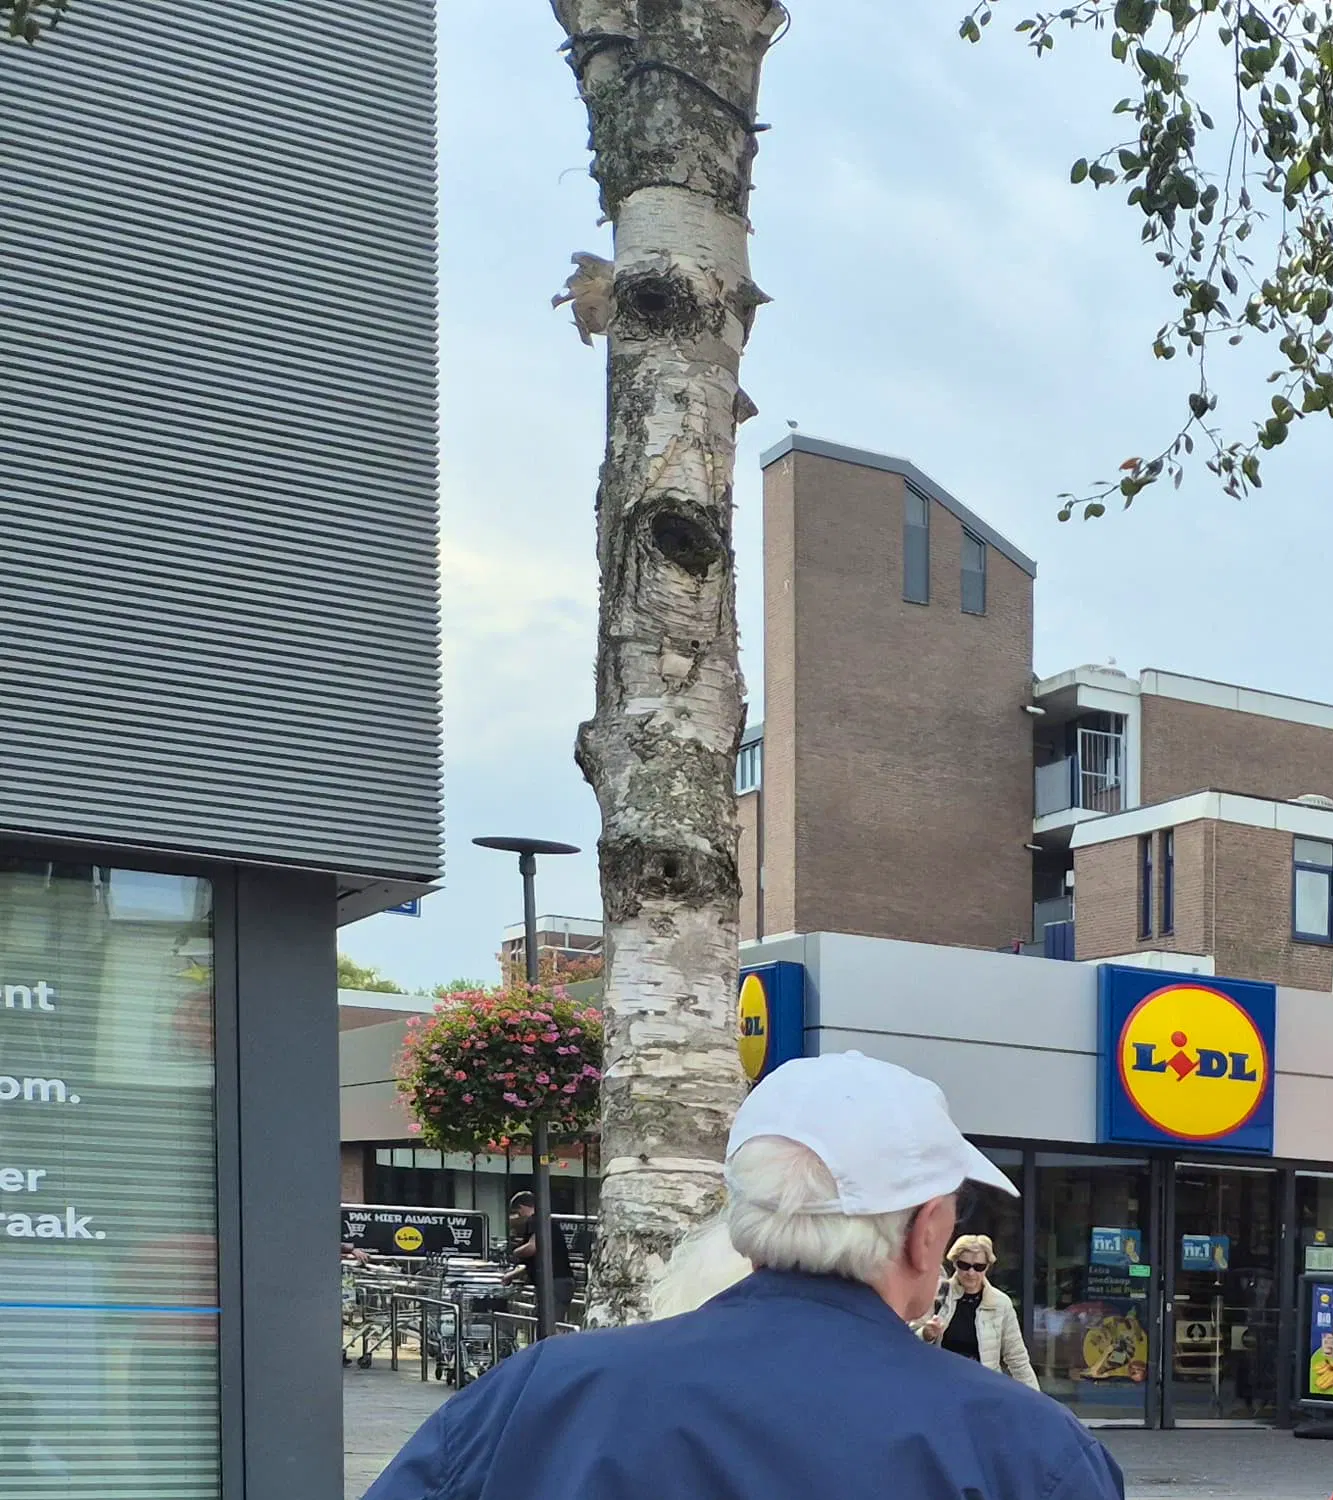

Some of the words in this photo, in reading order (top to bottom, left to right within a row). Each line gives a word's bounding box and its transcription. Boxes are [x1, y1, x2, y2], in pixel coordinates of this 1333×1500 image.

[349, 1211, 372, 1222] PAK
[374, 1213, 402, 1223] HIER
[404, 1214, 445, 1225] ALVAST
[447, 1216, 467, 1227] UW
[1093, 1236, 1121, 1251] nr.1
[1184, 1242, 1211, 1258] nr.1
